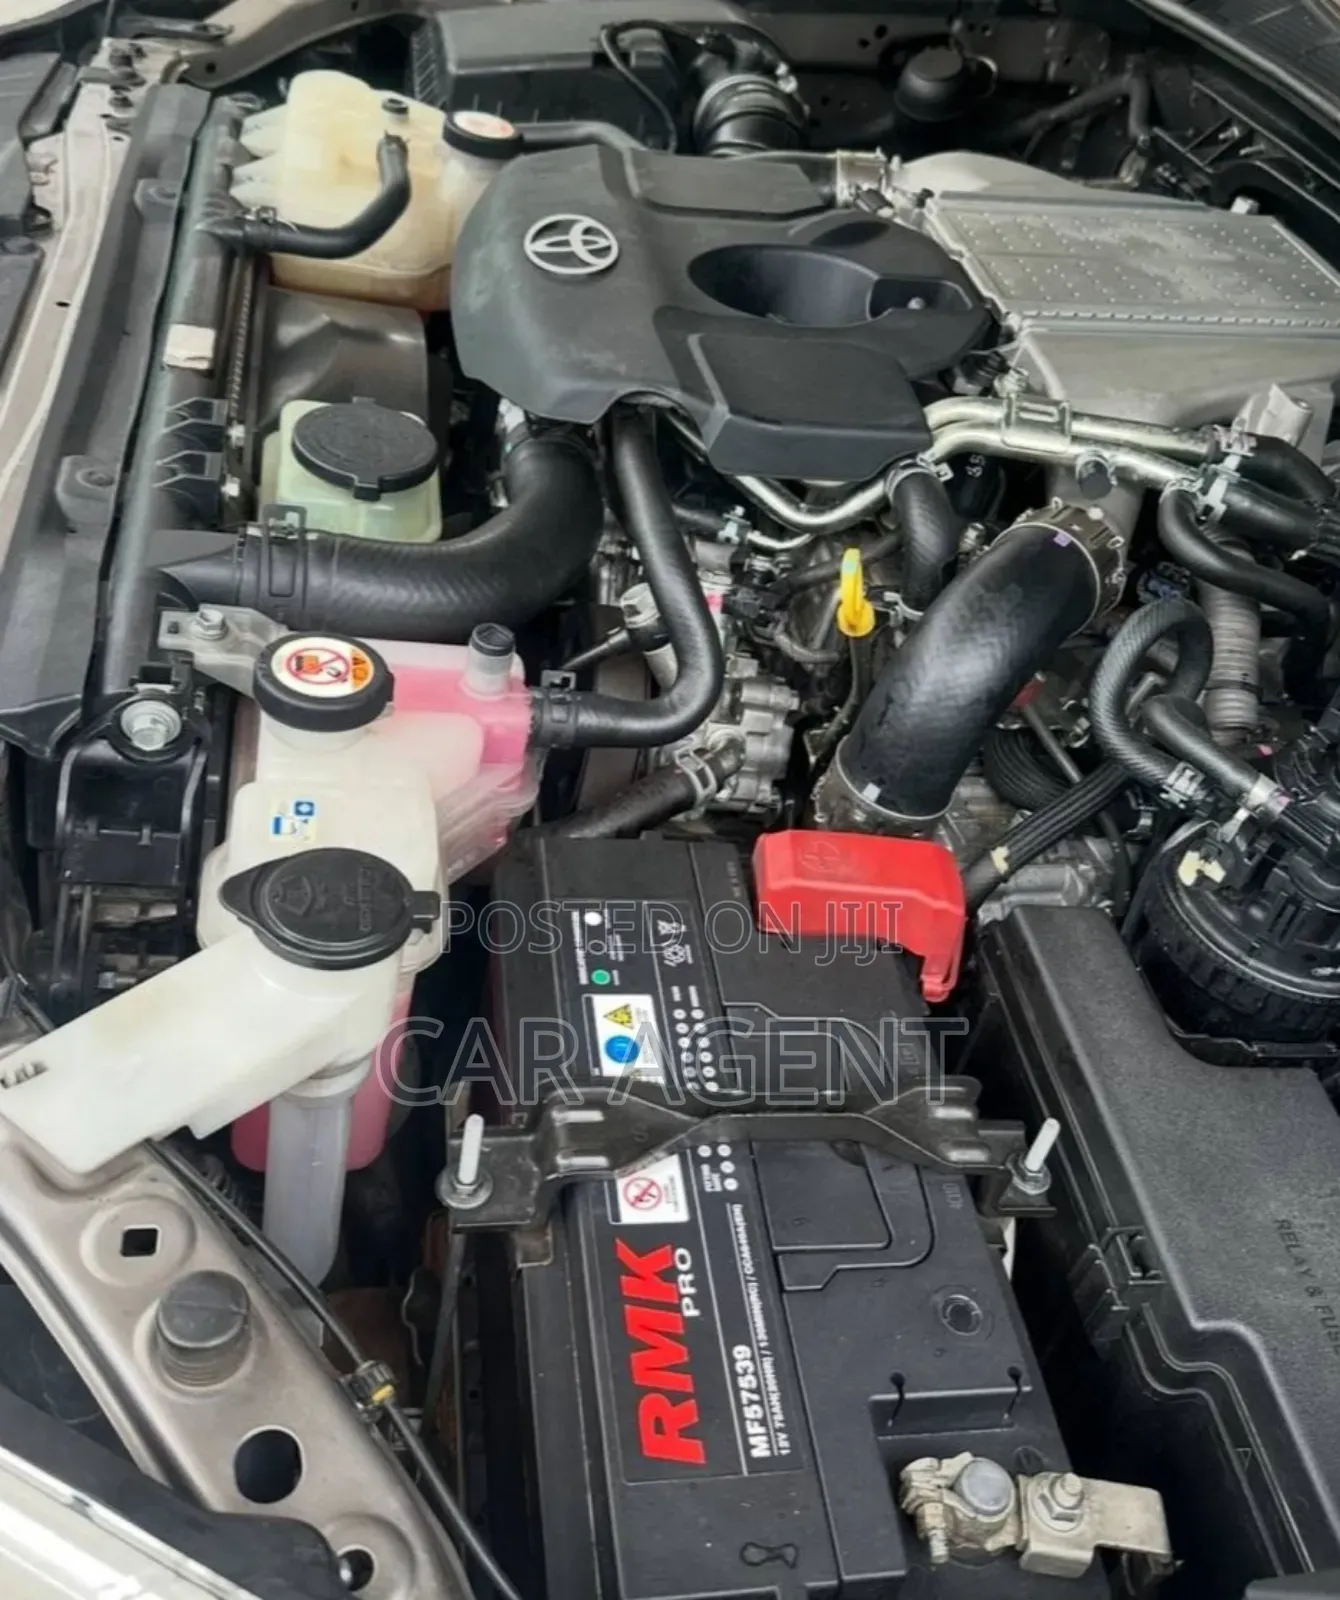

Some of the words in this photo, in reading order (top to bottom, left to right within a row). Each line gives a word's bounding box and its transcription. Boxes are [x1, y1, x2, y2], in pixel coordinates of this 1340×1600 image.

[673, 1247, 701, 1317] PRO
[1274, 1218, 1317, 1278] RELAY
[614, 1237, 706, 1465] RMK
[731, 1343, 772, 1459] MF57539
